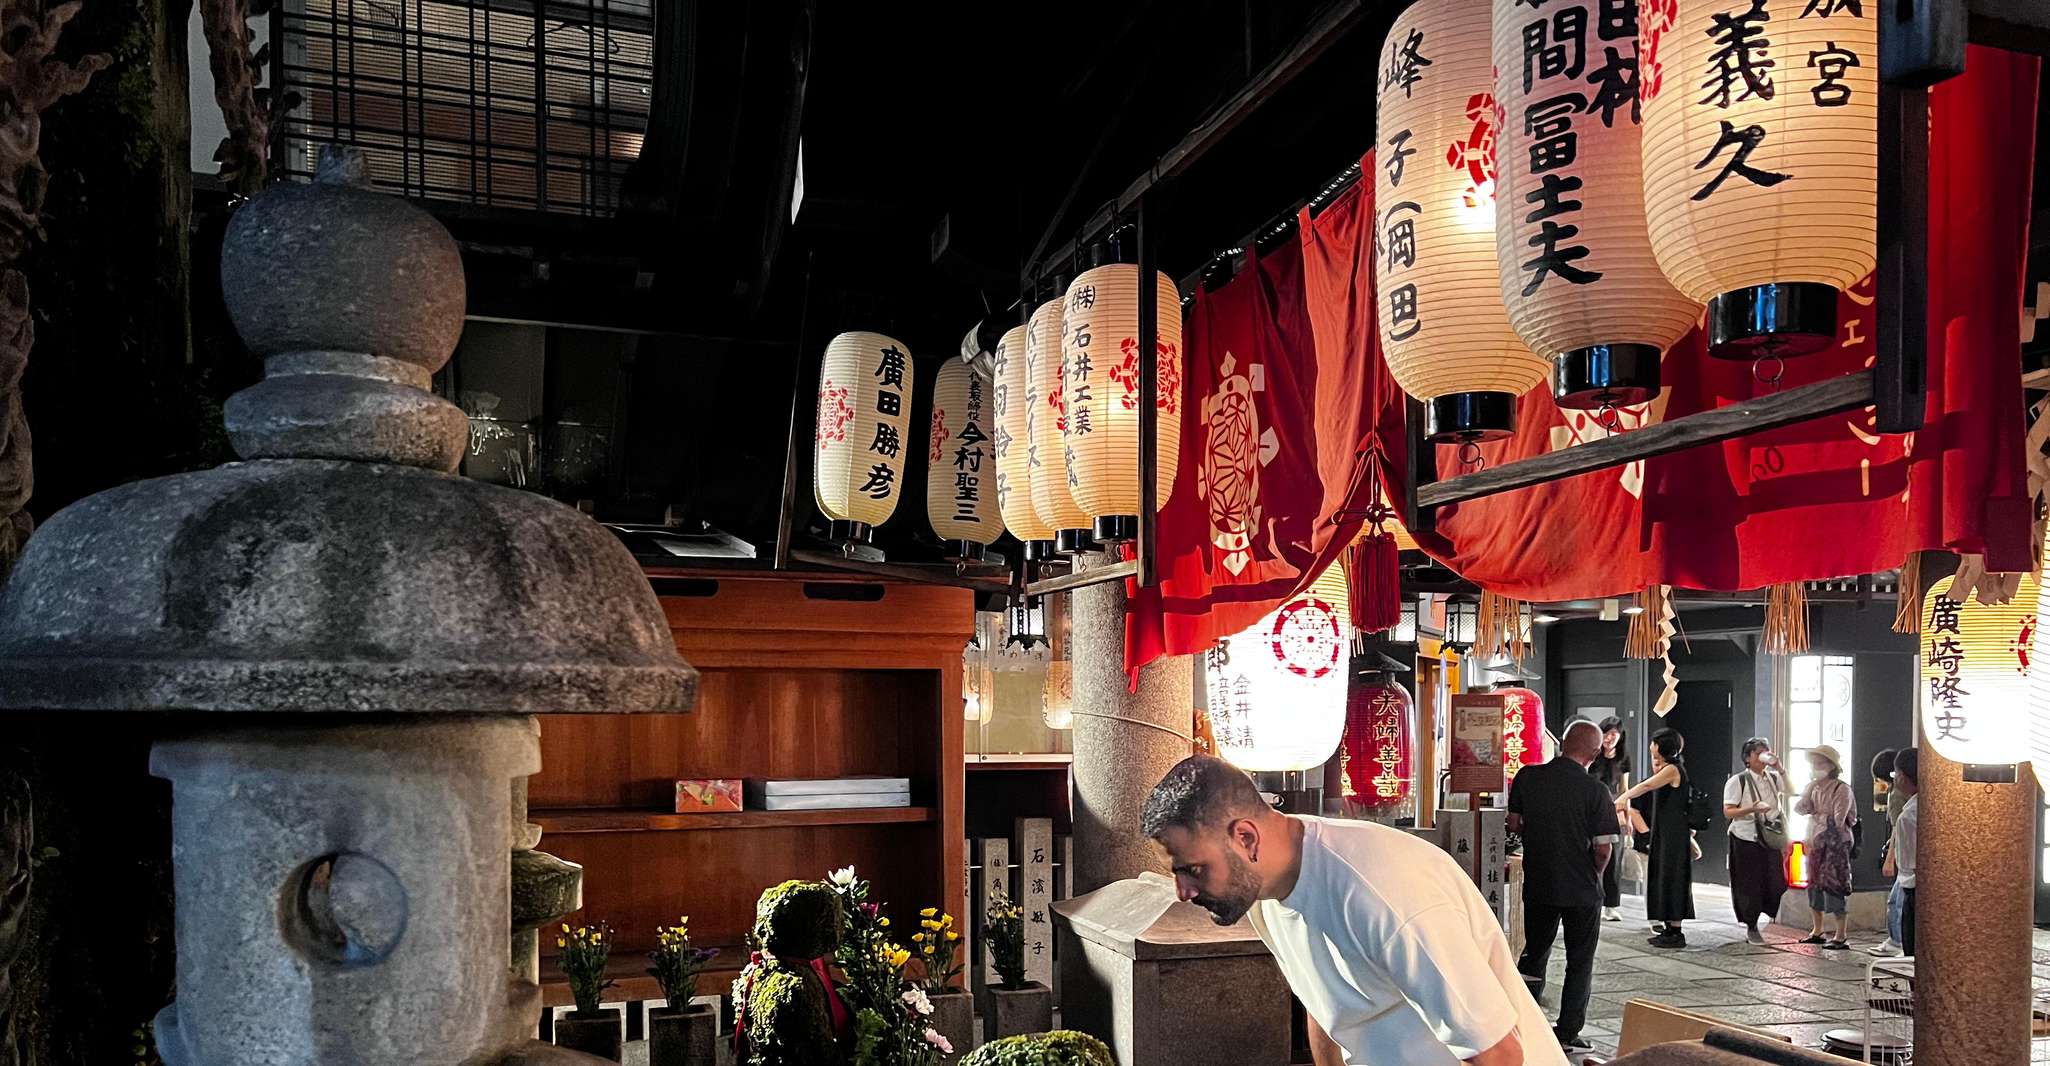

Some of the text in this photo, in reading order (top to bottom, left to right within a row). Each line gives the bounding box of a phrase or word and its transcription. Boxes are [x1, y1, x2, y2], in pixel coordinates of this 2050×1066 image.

[1798, 0, 1864, 108] 宮
[1515, 0, 1603, 297] 間冨士夫
[1372, 690, 1403, 797] 夫婦善哉
